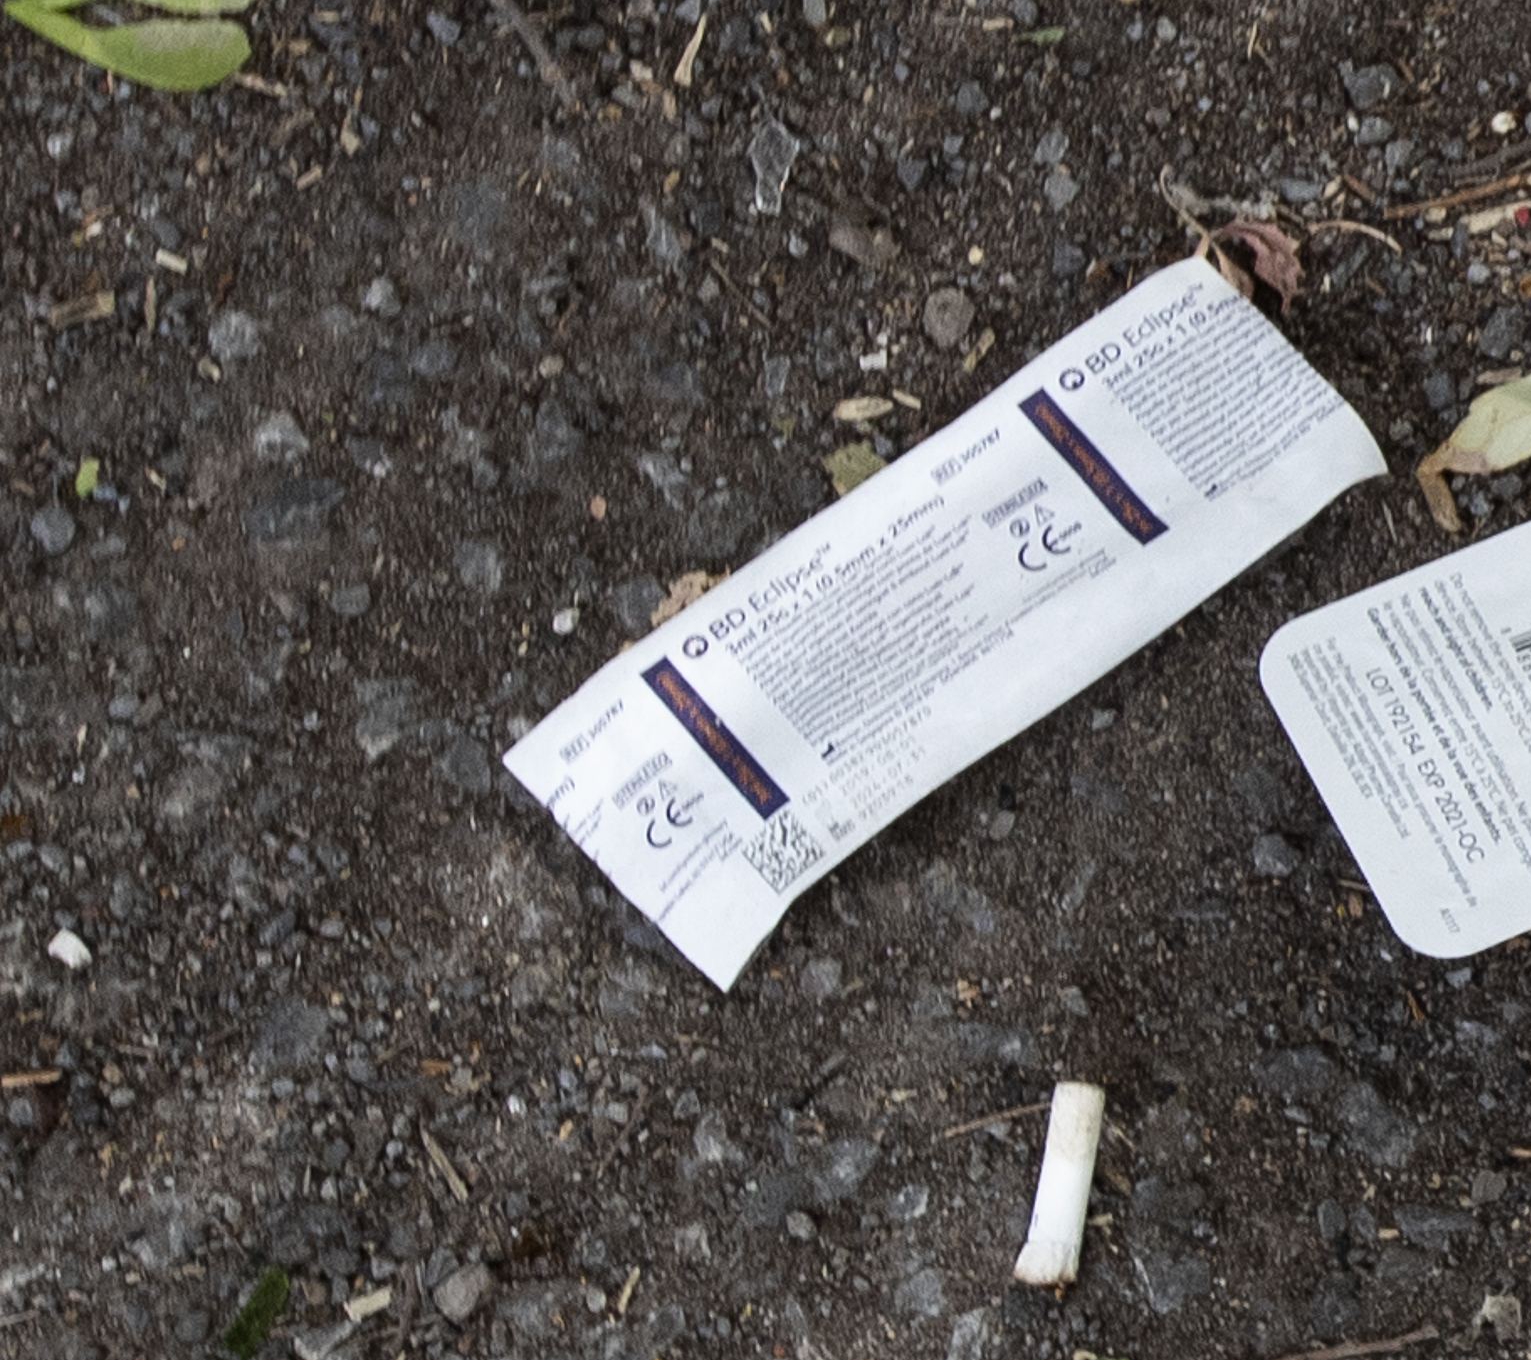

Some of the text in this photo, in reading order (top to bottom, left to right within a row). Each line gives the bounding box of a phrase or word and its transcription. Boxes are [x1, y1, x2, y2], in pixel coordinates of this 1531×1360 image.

[1084, 343, 1122, 375] BD
[708, 609, 746, 641] BD
[1365, 667, 1395, 696] LOT
[1384, 697, 1425, 756] 192154
[1417, 759, 1446, 789] EXP
[1435, 791, 1485, 863] 2021-OC
